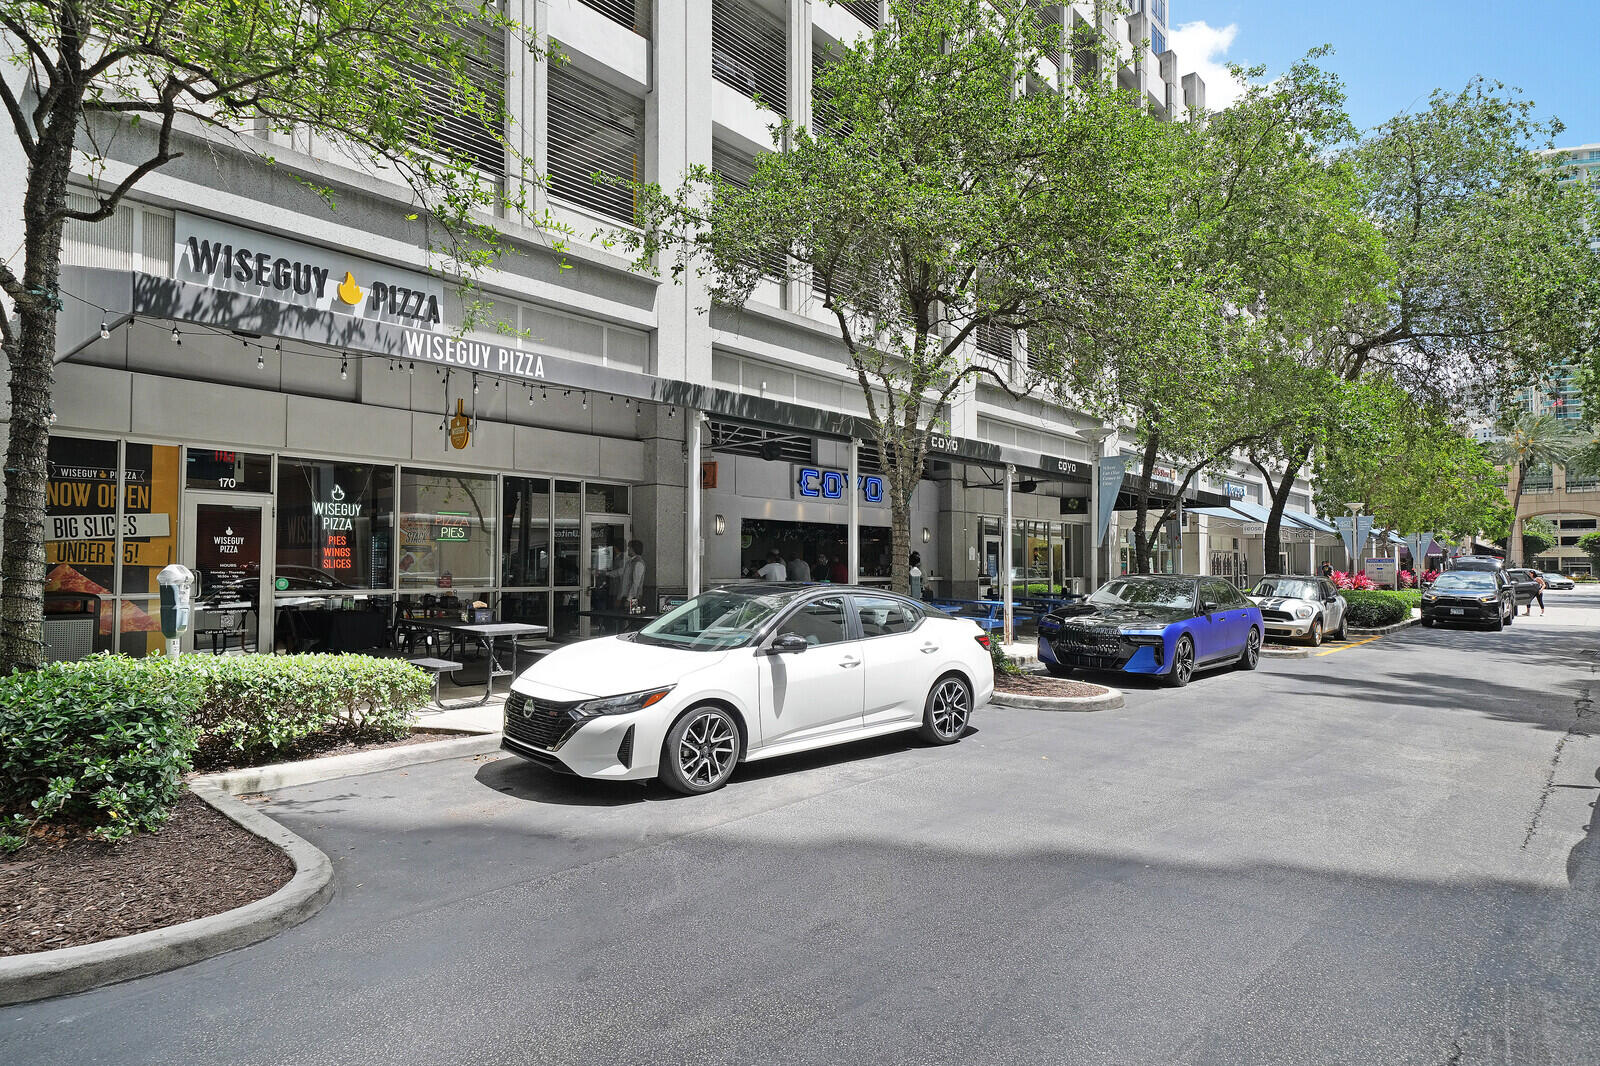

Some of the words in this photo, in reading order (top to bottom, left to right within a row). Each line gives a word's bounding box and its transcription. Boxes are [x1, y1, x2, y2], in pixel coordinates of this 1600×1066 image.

[188, 236, 329, 299] WISEGUY
[371, 280, 441, 325] PIZZA
[405, 330, 491, 369] WISEGUY
[499, 348, 545, 379] PIZZA
[931, 436, 958, 452] COYO
[60, 468, 98, 478] WISEGUY
[1058, 460, 1077, 474] COYO
[218, 477, 236, 488] 170
[46, 482, 92, 507] NOW
[313, 502, 362, 516] WISEGUY
[323, 517, 353, 531] PIZZA
[435, 514, 470, 527] PIZZA
[53, 517, 79, 539] BIG
[440, 527, 465, 539] PIES
[213, 536, 245, 545] WISEGUY
[328, 535, 347, 546] PIES
[57, 542, 106, 563] UNDER
[219, 545, 238, 553] PIZZA
[323, 547, 351, 557] WINGS
[323, 559, 352, 569] SLICES
